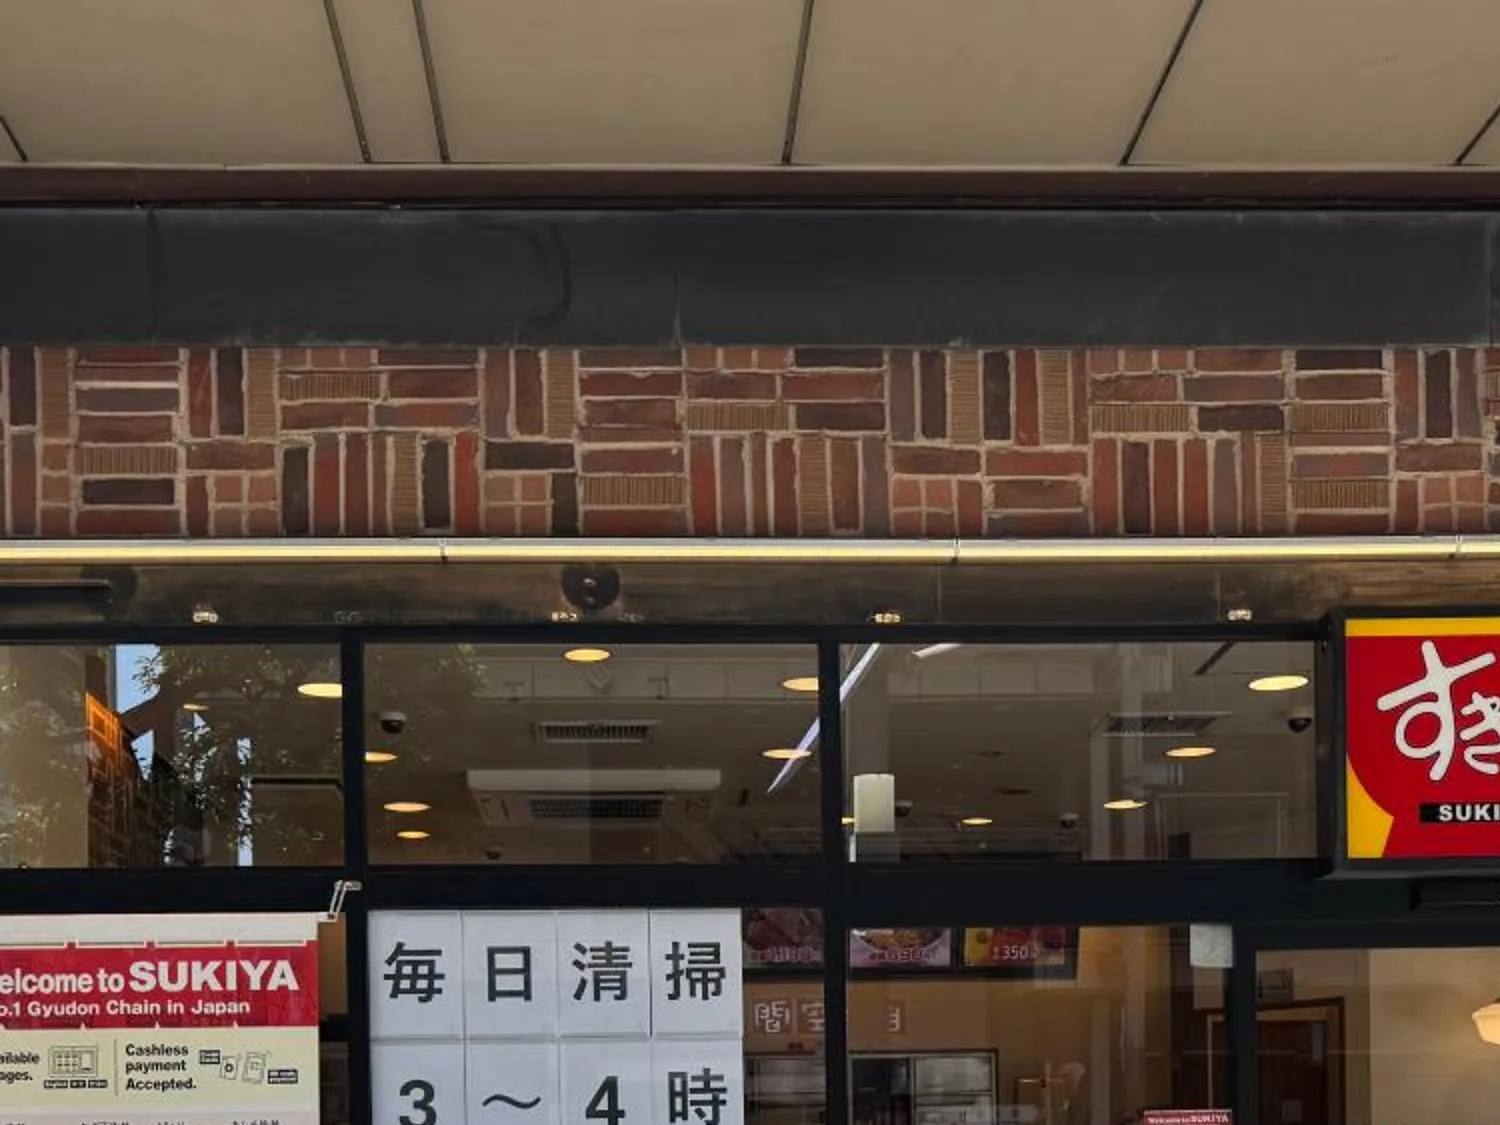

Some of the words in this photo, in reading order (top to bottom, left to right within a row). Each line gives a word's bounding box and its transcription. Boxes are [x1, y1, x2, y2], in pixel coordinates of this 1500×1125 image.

[98, 968, 125, 993] to
[129, 960, 299, 993] SUKIYA
[383, 941, 726, 1003] 毎日清掃
[27, 1001, 100, 1018] Gyudon
[106, 1000, 160, 1015] Chain
[168, 1000, 184, 1014] in
[191, 999, 250, 1016] Japan
[125, 1044, 188, 1057] Cashless
[125, 1060, 187, 1075] payment
[125, 1077, 197, 1092] Accepted.
